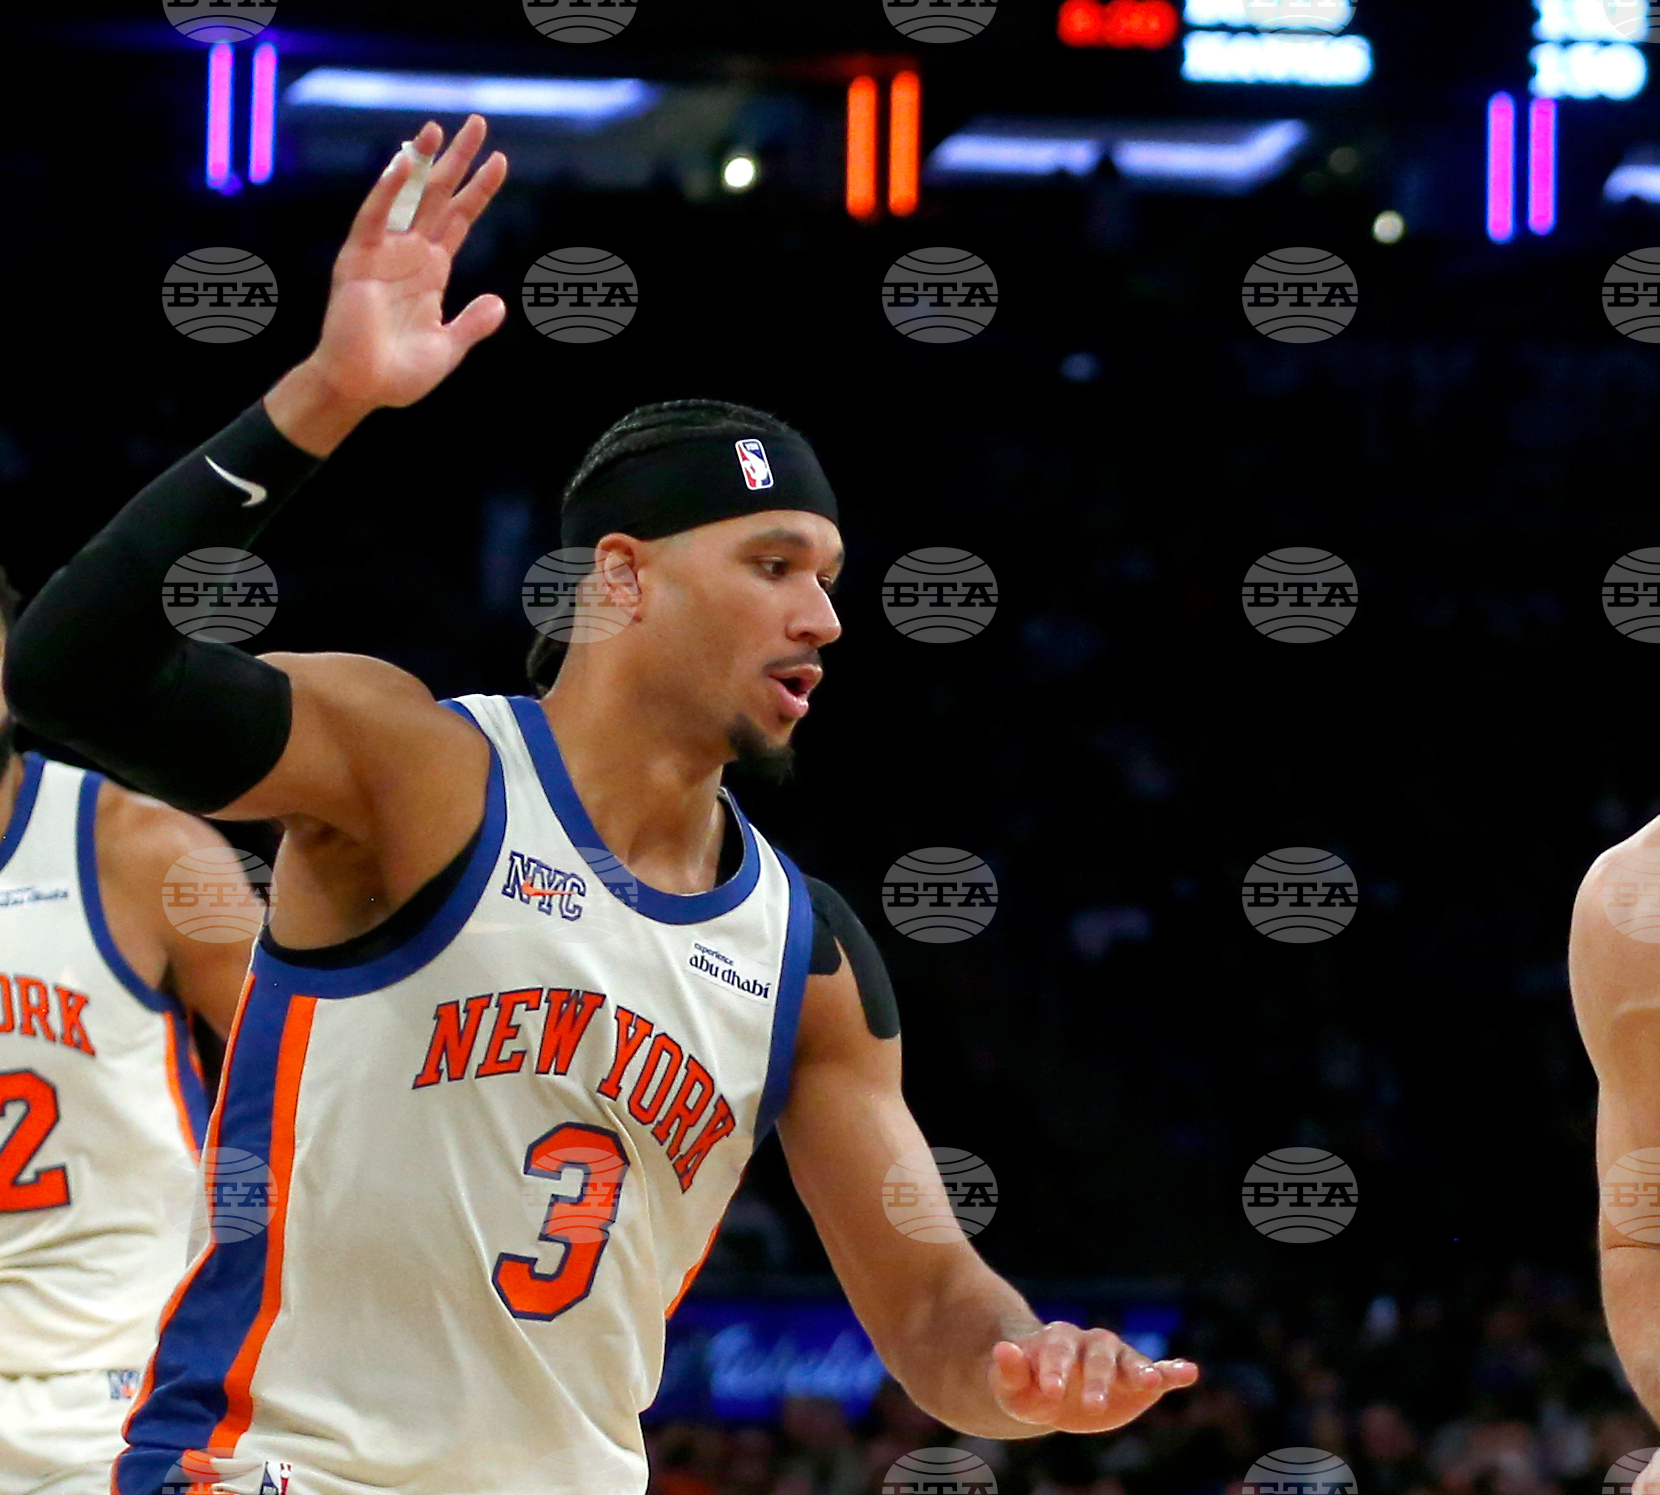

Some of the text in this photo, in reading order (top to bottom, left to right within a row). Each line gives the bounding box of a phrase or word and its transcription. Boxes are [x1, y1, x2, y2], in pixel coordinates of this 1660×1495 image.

[501, 850, 587, 921] NYC
[688, 954, 771, 999] abu dhabi
[412, 988, 736, 1194] NEW YORK
[492, 1121, 630, 1322] 3
